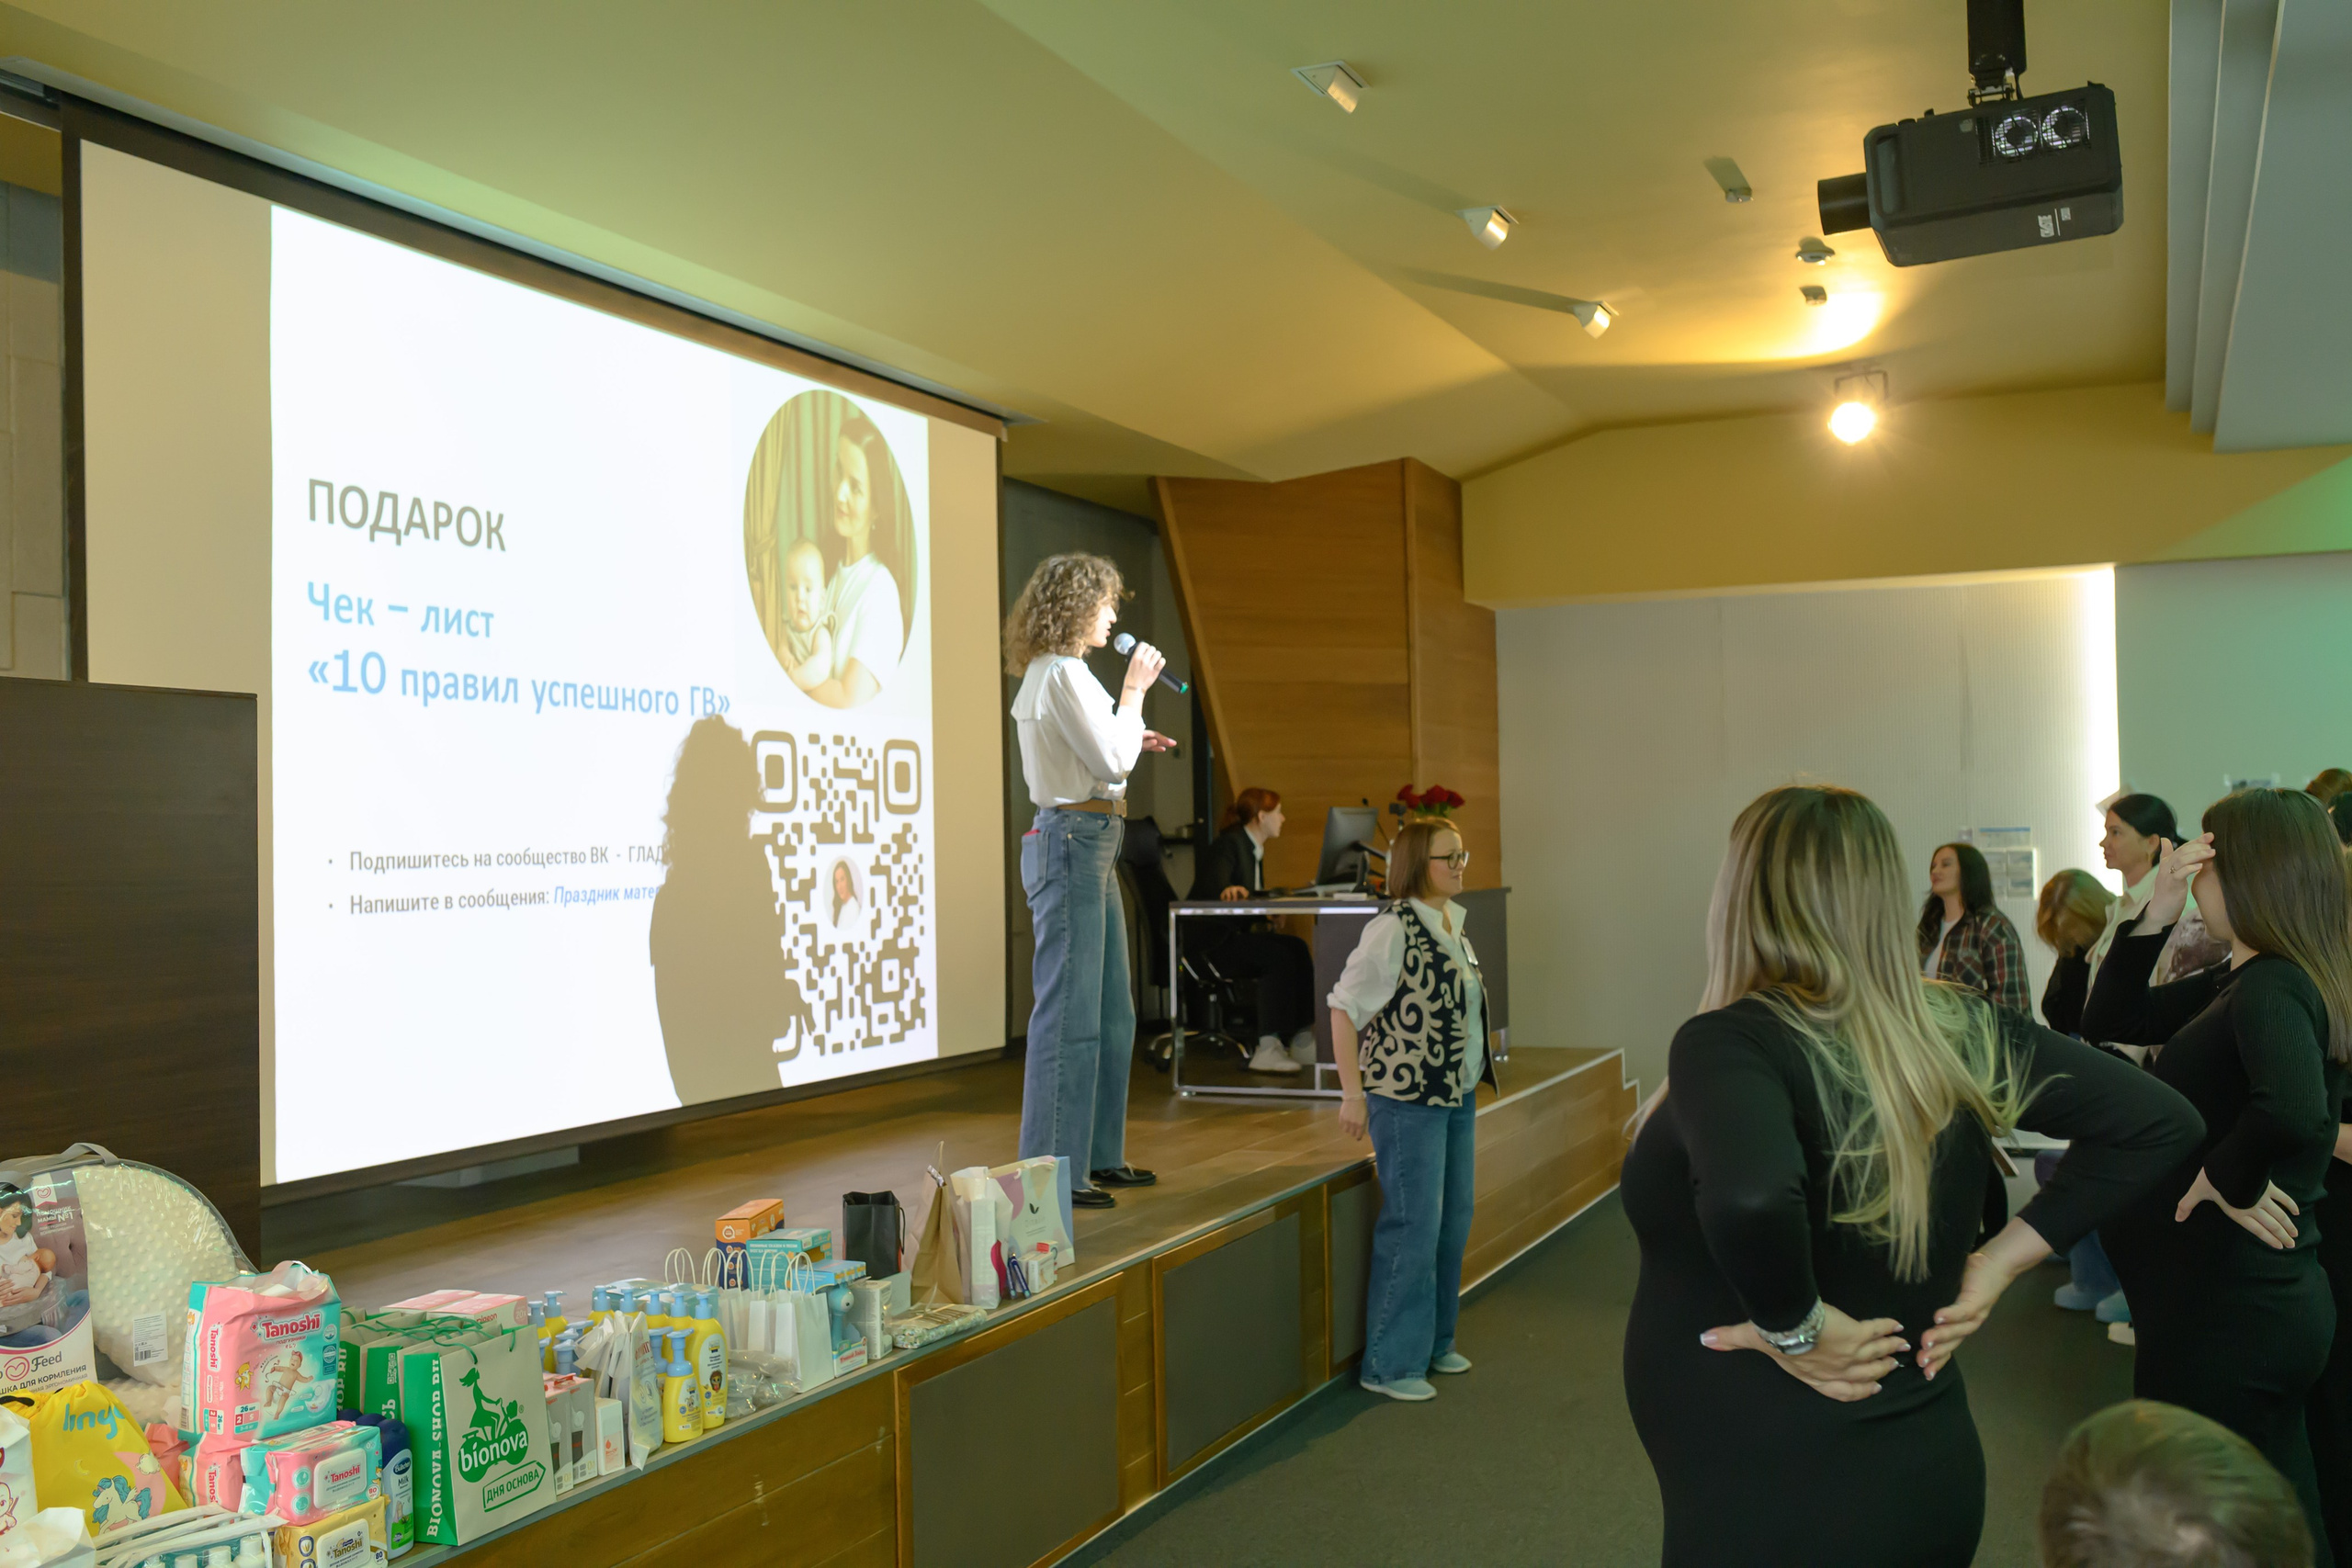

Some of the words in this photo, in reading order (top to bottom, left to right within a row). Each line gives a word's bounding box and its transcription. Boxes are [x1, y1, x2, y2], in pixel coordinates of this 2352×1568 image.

[309, 478, 506, 552] ПОДАРОК
[308, 581, 375, 626] Чек
[421, 605, 494, 638] лист
[308, 649, 387, 694] «10
[401, 668, 519, 707] правил
[531, 679, 679, 716] успешного
[690, 685, 730, 717] ГВ»
[349, 851, 469, 874] Подпишитесь
[474, 852, 492, 867] на
[496, 846, 587, 869] сообщество
[591, 846, 609, 864] ВК
[349, 894, 440, 915] Напишите
[444, 896, 454, 910] в
[458, 887, 550, 910] сообщения:
[554, 886, 620, 908] Праздник
[19, 1379, 36, 1390] ДЛЯ
[38, 1364, 87, 1384] КОРМЛЕНИЯ
[30, 1350, 62, 1373] Feed
[235, 1416, 243, 1425] 2
[459, 1429, 528, 1473] bionova
[208, 1470, 219, 1504] Tanos
[486, 1486, 505, 1506] ДНЯ
[505, 1468, 540, 1494] ОСНОВА
[375, 1551, 384, 1560] 80
